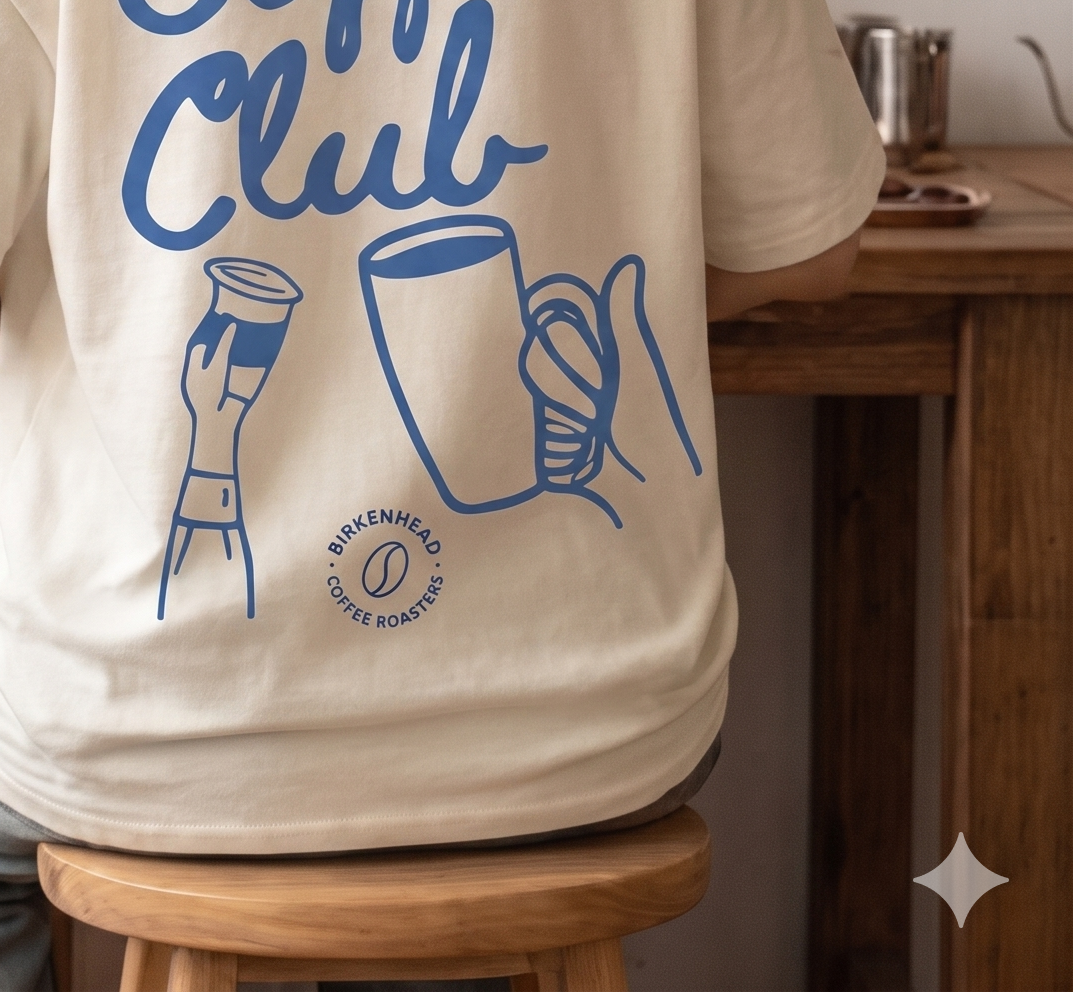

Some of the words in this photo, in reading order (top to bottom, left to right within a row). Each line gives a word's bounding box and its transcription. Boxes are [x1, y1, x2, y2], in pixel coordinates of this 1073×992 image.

[327, 508, 442, 556] BIRKENHEAD
[327, 575, 373, 626] COFFEE
[376, 574, 444, 629] ROASTERS
